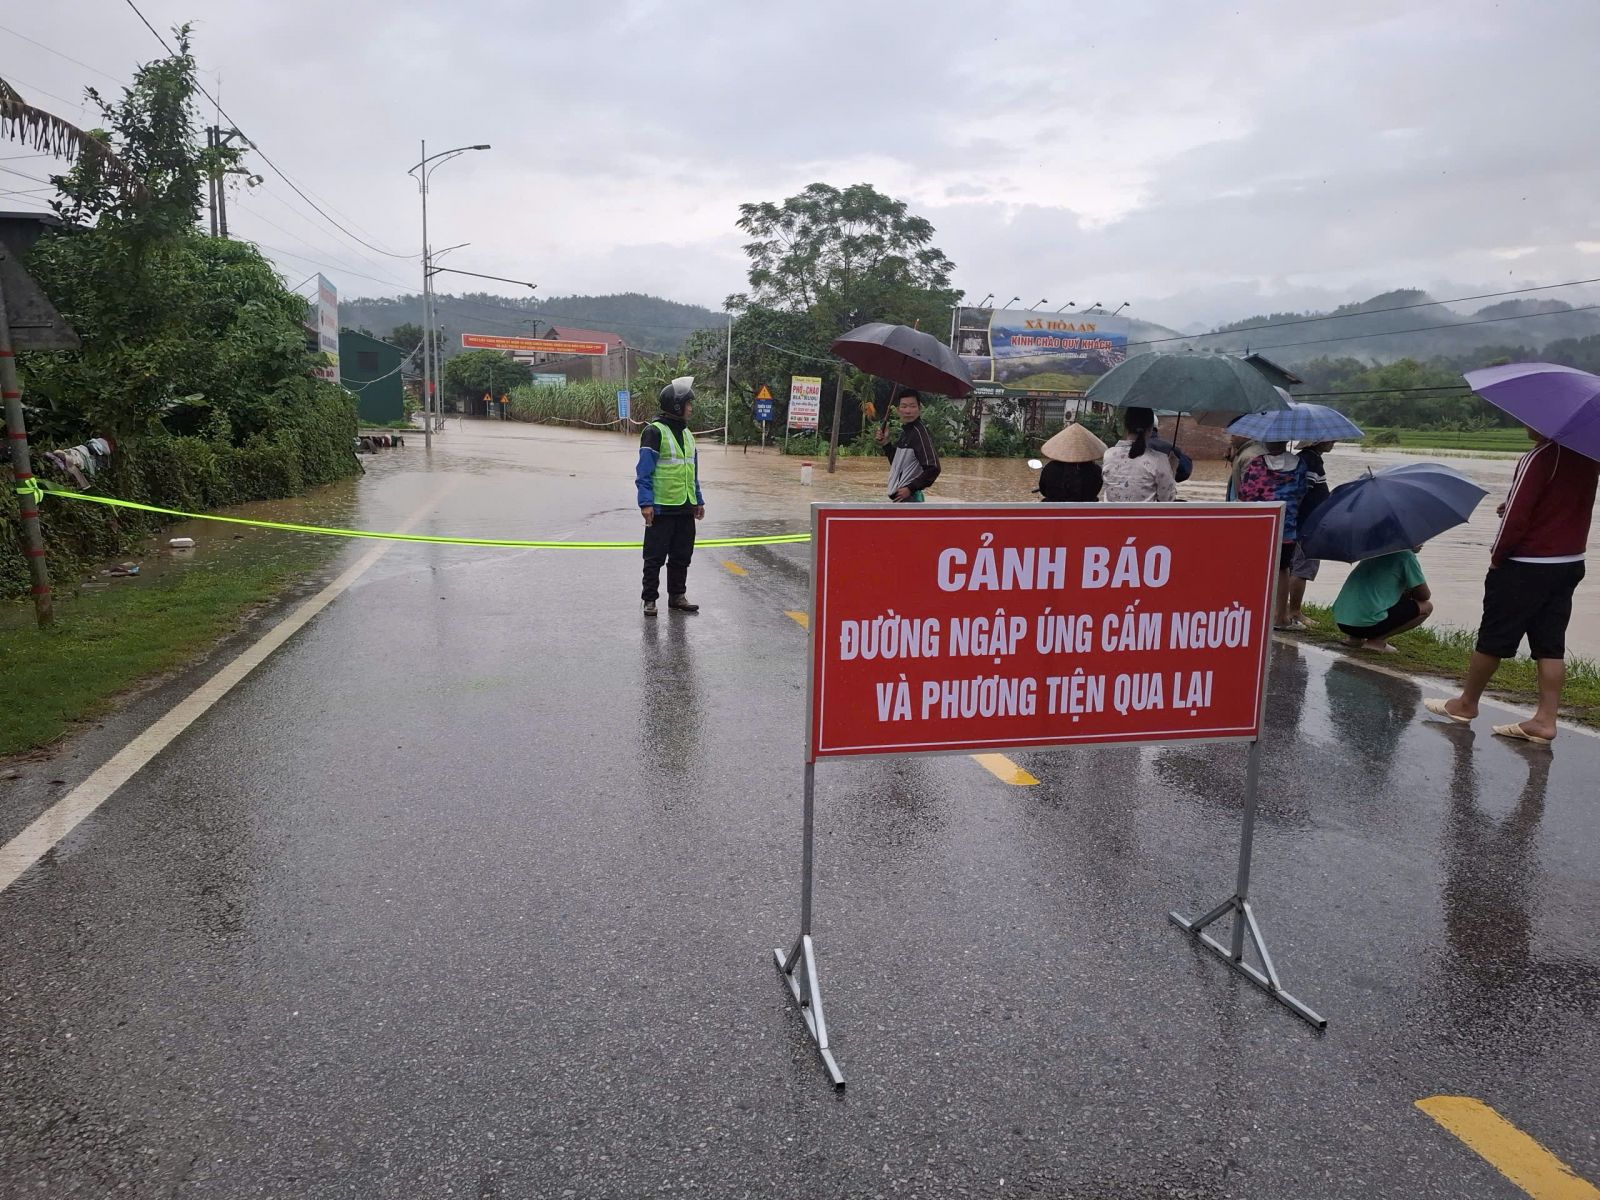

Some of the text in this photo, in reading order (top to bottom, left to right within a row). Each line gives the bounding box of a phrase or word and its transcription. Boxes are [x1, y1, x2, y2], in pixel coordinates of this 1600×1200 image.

[1010, 333, 1112, 351] KÍNH CHÀO QUÝ KHÁCH
[1024, 318, 1096, 332] XÃ HÒA AN
[938, 533, 1172, 591] CẢNH BÁO
[840, 600, 1251, 663] ĐƯỜNG NGẬP ÚNG CẤM NGƯỜI
[877, 667, 1213, 722] VÀ PHƯƠNG TIỆN QUA LẠI
